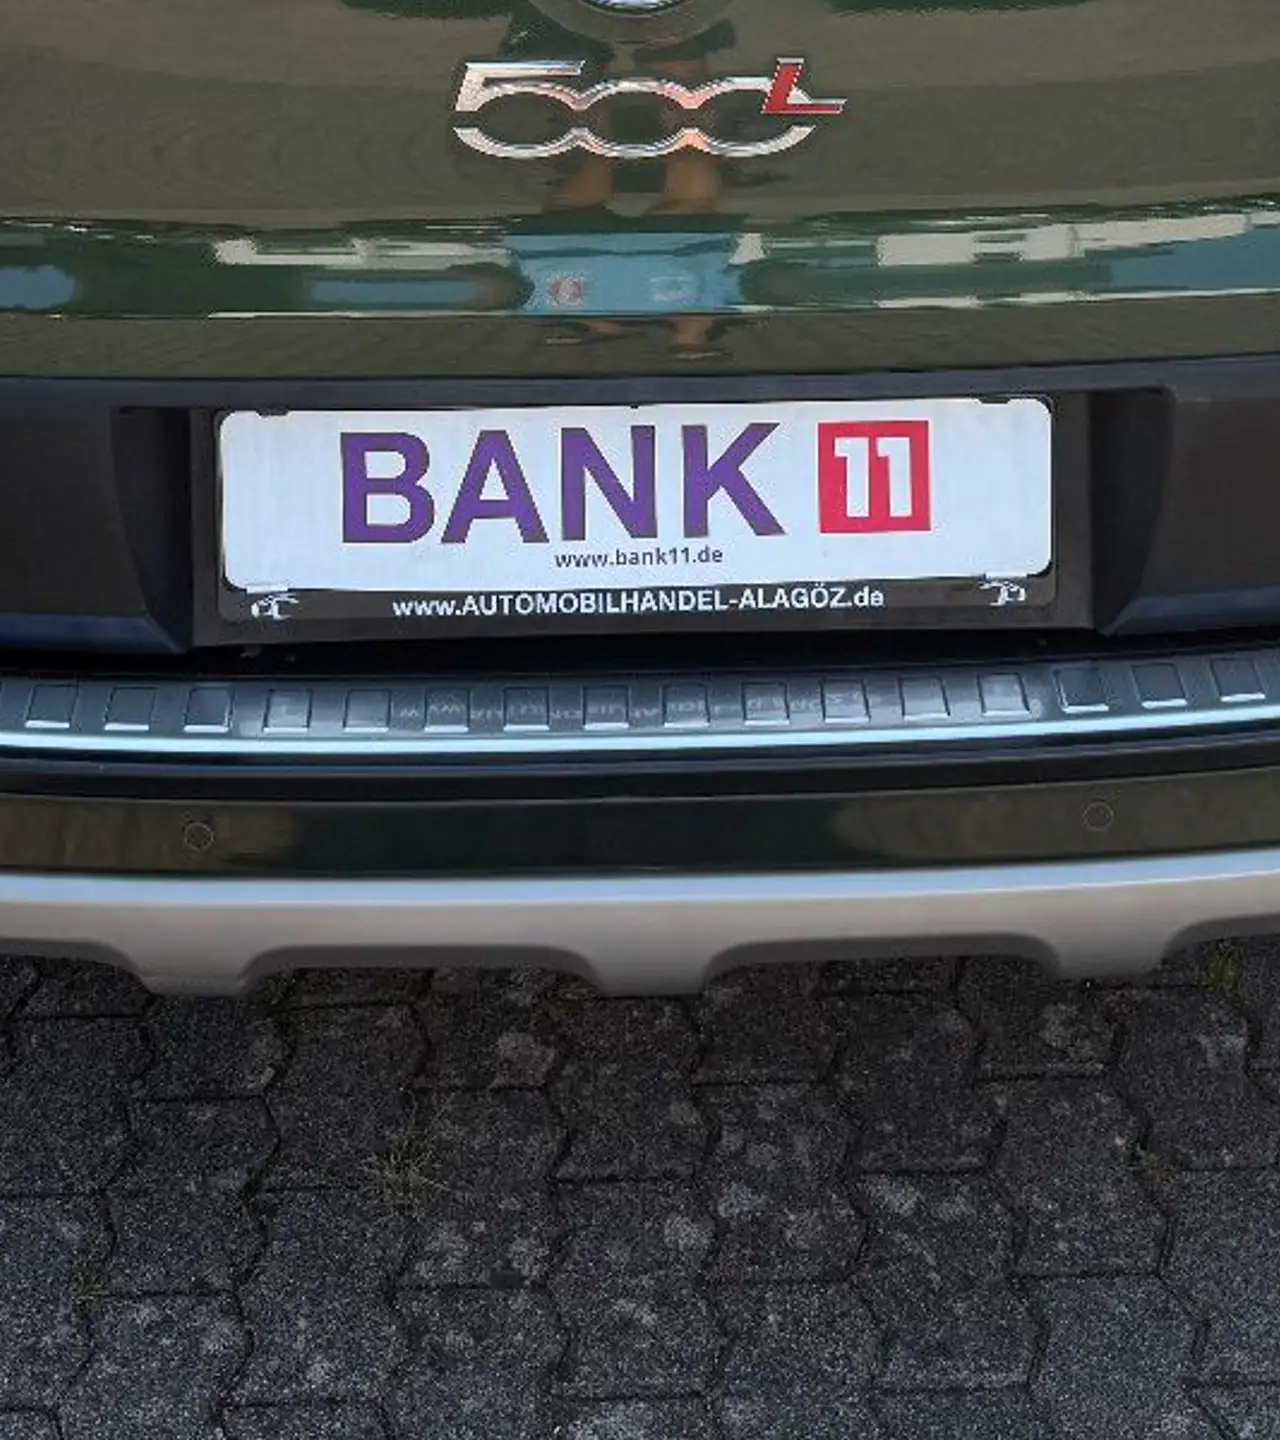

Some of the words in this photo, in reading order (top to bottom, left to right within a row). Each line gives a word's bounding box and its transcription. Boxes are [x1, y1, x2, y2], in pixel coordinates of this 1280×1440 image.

[340, 422, 786, 544] BANK
[828, 430, 918, 522] 11
[554, 546, 724, 568] www.bank11.de
[392, 583, 885, 617] www.AUTOMOBILHANDEL-ALAGÖZ.de
